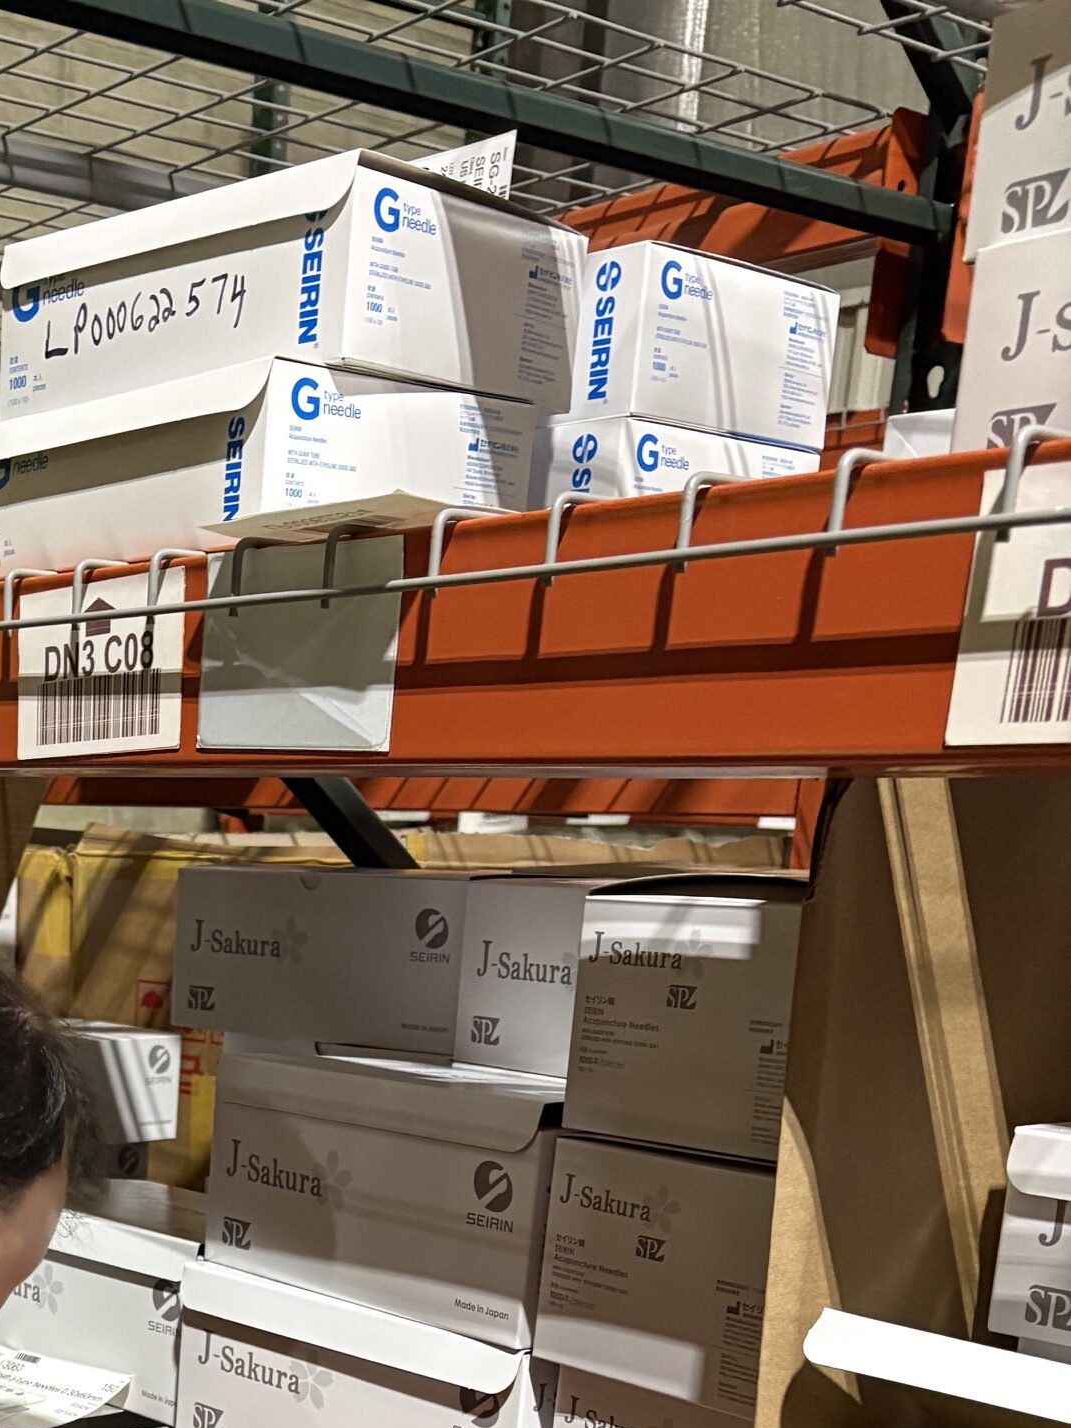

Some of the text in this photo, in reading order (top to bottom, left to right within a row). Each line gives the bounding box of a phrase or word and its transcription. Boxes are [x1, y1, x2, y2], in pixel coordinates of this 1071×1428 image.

[374, 187, 401, 233] G
[402, 215, 437, 237] needle
[403, 202, 421, 217] type
[42, 279, 85, 306] needle
[298, 226, 326, 345] SEIRIN
[661, 260, 683, 300] G
[684, 283, 713, 301] needle
[587, 295, 615, 401] SEIRIN
[8, 375, 27, 390] 1000
[290, 377, 321, 420] G
[324, 390, 344, 402] type
[323, 403, 361, 419] needle
[12, 453, 49, 475] needle
[636, 433, 659, 472] G
[660, 455, 689, 471] needle
[661, 444, 677, 456] type
[223, 416, 246, 522] SEIRIN
[285, 488, 302, 498] 1000
[44, 630, 155, 682] DN3 C08
[190, 919, 282, 959] J-Sakura
[588, 931, 683, 970] J-Sakura
[409, 952, 451, 965] SEIRIN
[475, 940, 573, 987] J-Sakura
[226, 1139, 322, 1198] J-Sakura
[560, 1173, 652, 1223] J-Sakura
[465, 1212, 514, 1233] SEIRIN
[454, 1299, 509, 1321] Made in Japan
[197, 1330, 300, 1395] J-Sakura
